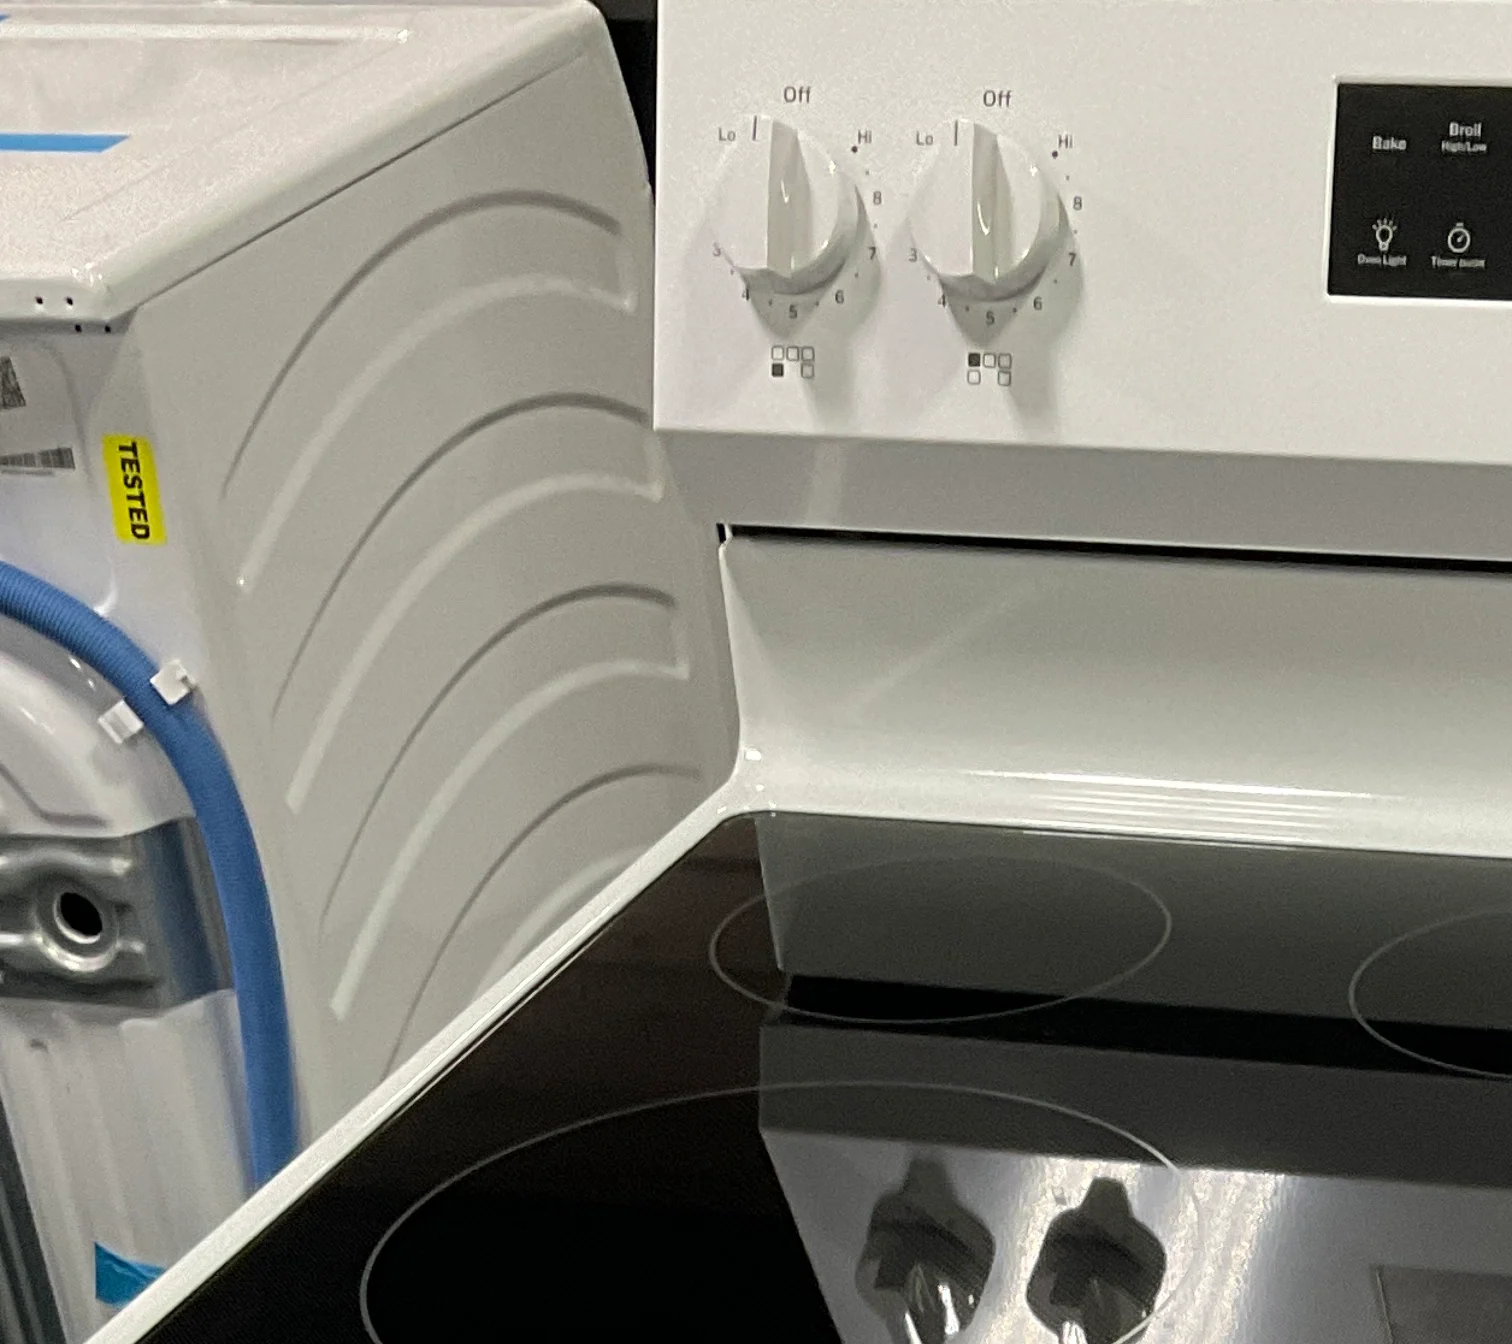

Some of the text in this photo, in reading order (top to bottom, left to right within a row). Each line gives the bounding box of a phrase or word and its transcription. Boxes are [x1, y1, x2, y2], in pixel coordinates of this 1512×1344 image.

[783, 86, 811, 103] Off
[983, 90, 1012, 108] Off
[718, 127, 736, 142] Lo
[858, 130, 871, 144] Hi
[1450, 122, 1482, 137] Broil
[916, 131, 933, 146] Lo
[1058, 134, 1073, 149] Hi
[1372, 136, 1407, 151] Bake
[873, 191, 882, 205] 8
[1073, 196, 1083, 210] 8
[868, 247, 877, 260] 7
[908, 248, 917, 262] 3
[1068, 252, 1077, 267] 7
[835, 290, 844, 305] 6
[937, 294, 946, 308] 4
[1033, 296, 1042, 312] 6
[789, 304, 798, 319] 5
[986, 311, 995, 326] 5
[118, 441, 150, 540] TESTED
